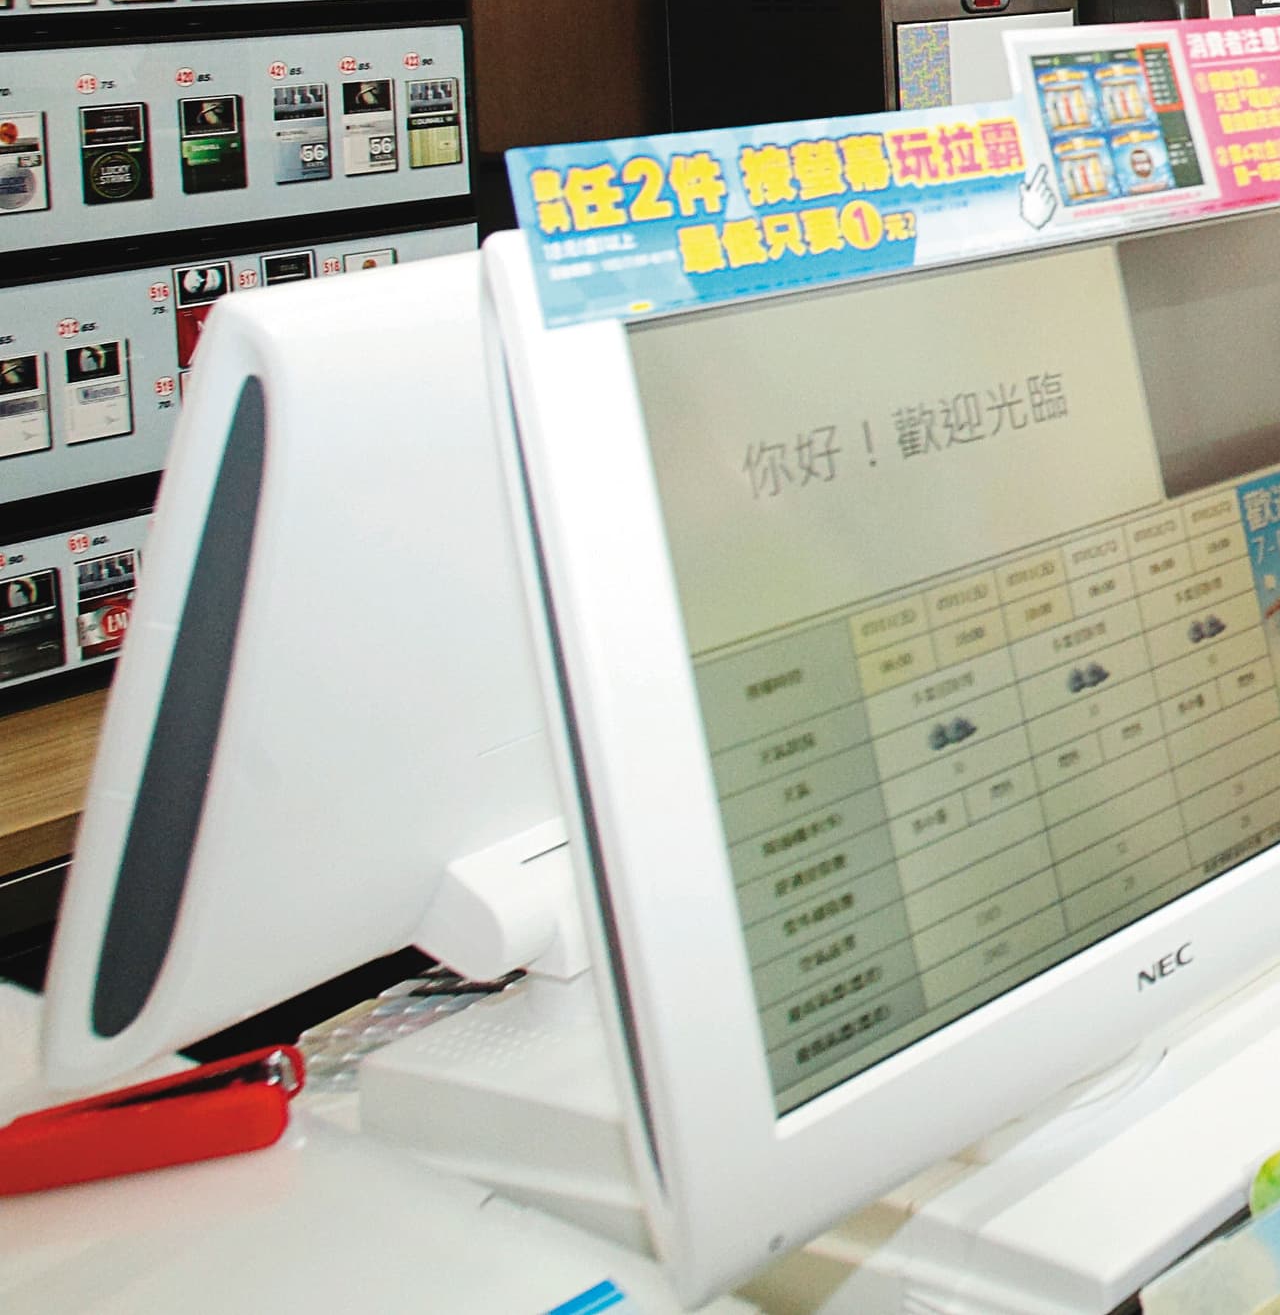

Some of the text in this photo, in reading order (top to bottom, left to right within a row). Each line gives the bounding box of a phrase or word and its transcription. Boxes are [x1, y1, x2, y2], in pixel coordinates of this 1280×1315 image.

[301, 144, 326, 162] 56
[371, 138, 393, 155] 56
[101, 165, 131, 176] LUCKY
[738, 117, 1029, 208] 按螢幕玩拉霸
[99, 174, 133, 185] STRIKE
[239, 272, 257, 286] 517
[1135, 940, 1195, 991] NEC
